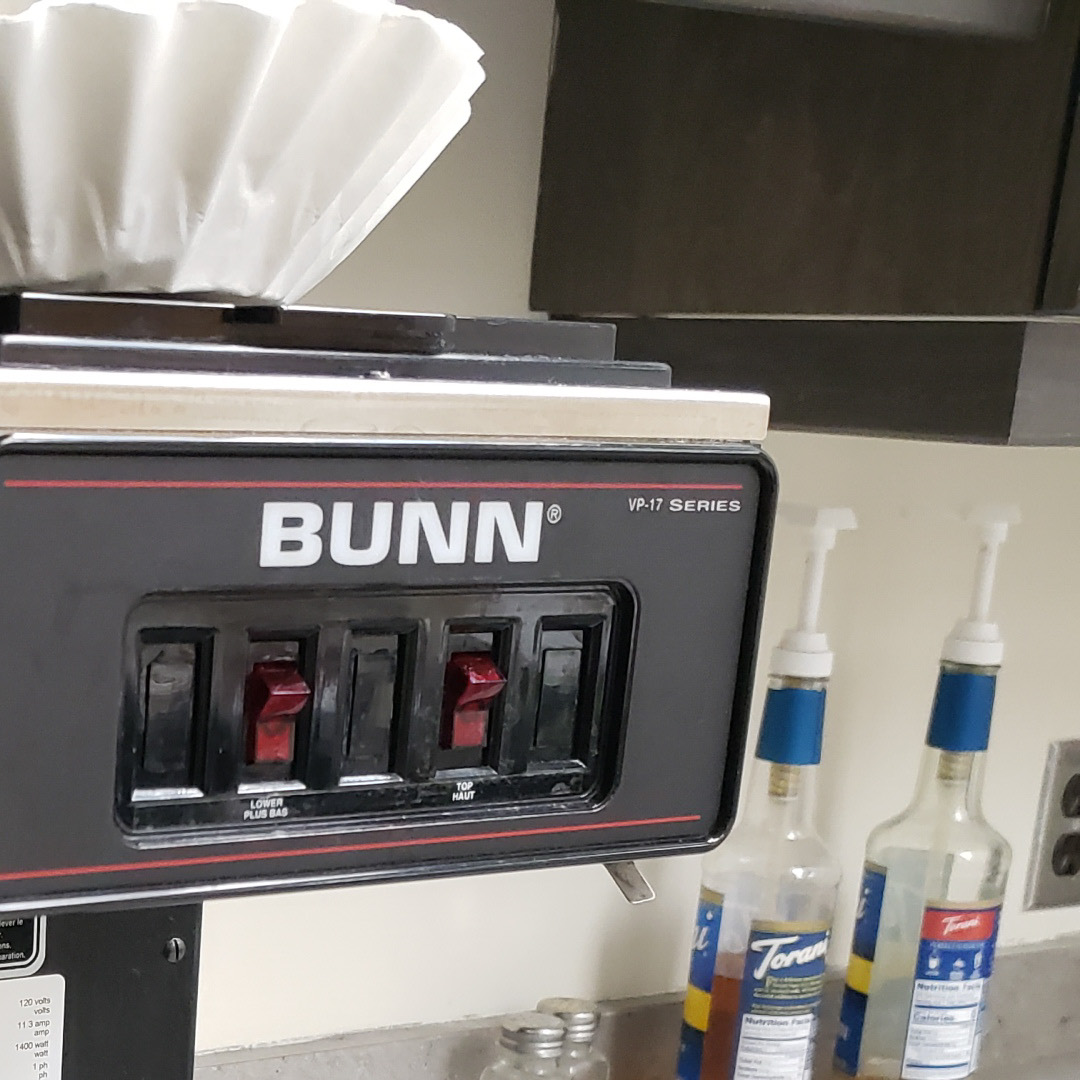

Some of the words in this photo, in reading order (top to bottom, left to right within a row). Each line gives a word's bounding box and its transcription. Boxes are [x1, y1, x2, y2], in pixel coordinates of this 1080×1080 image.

[628, 498, 662, 512] VP-17
[669, 499, 742, 512] SERIES
[456, 781, 474, 792] TOP
[452, 791, 475, 801] HAUT
[250, 798, 284, 810] LOWER
[243, 808, 268, 821] PLUS
[269, 807, 289, 818] BAS
[19, 998, 33, 1007] 120
[34, 997, 51, 1006] volts
[33, 1006, 51, 1015] volts
[34, 1019, 50, 1028] amp
[33, 1028, 50, 1037] amp
[15, 1041, 34, 1051] 1400
[34, 1040, 49, 1049] watt
[33, 1049, 49, 1058] watt
[38, 1061, 48, 1071] ph
[38, 1070, 48, 1080] ph
